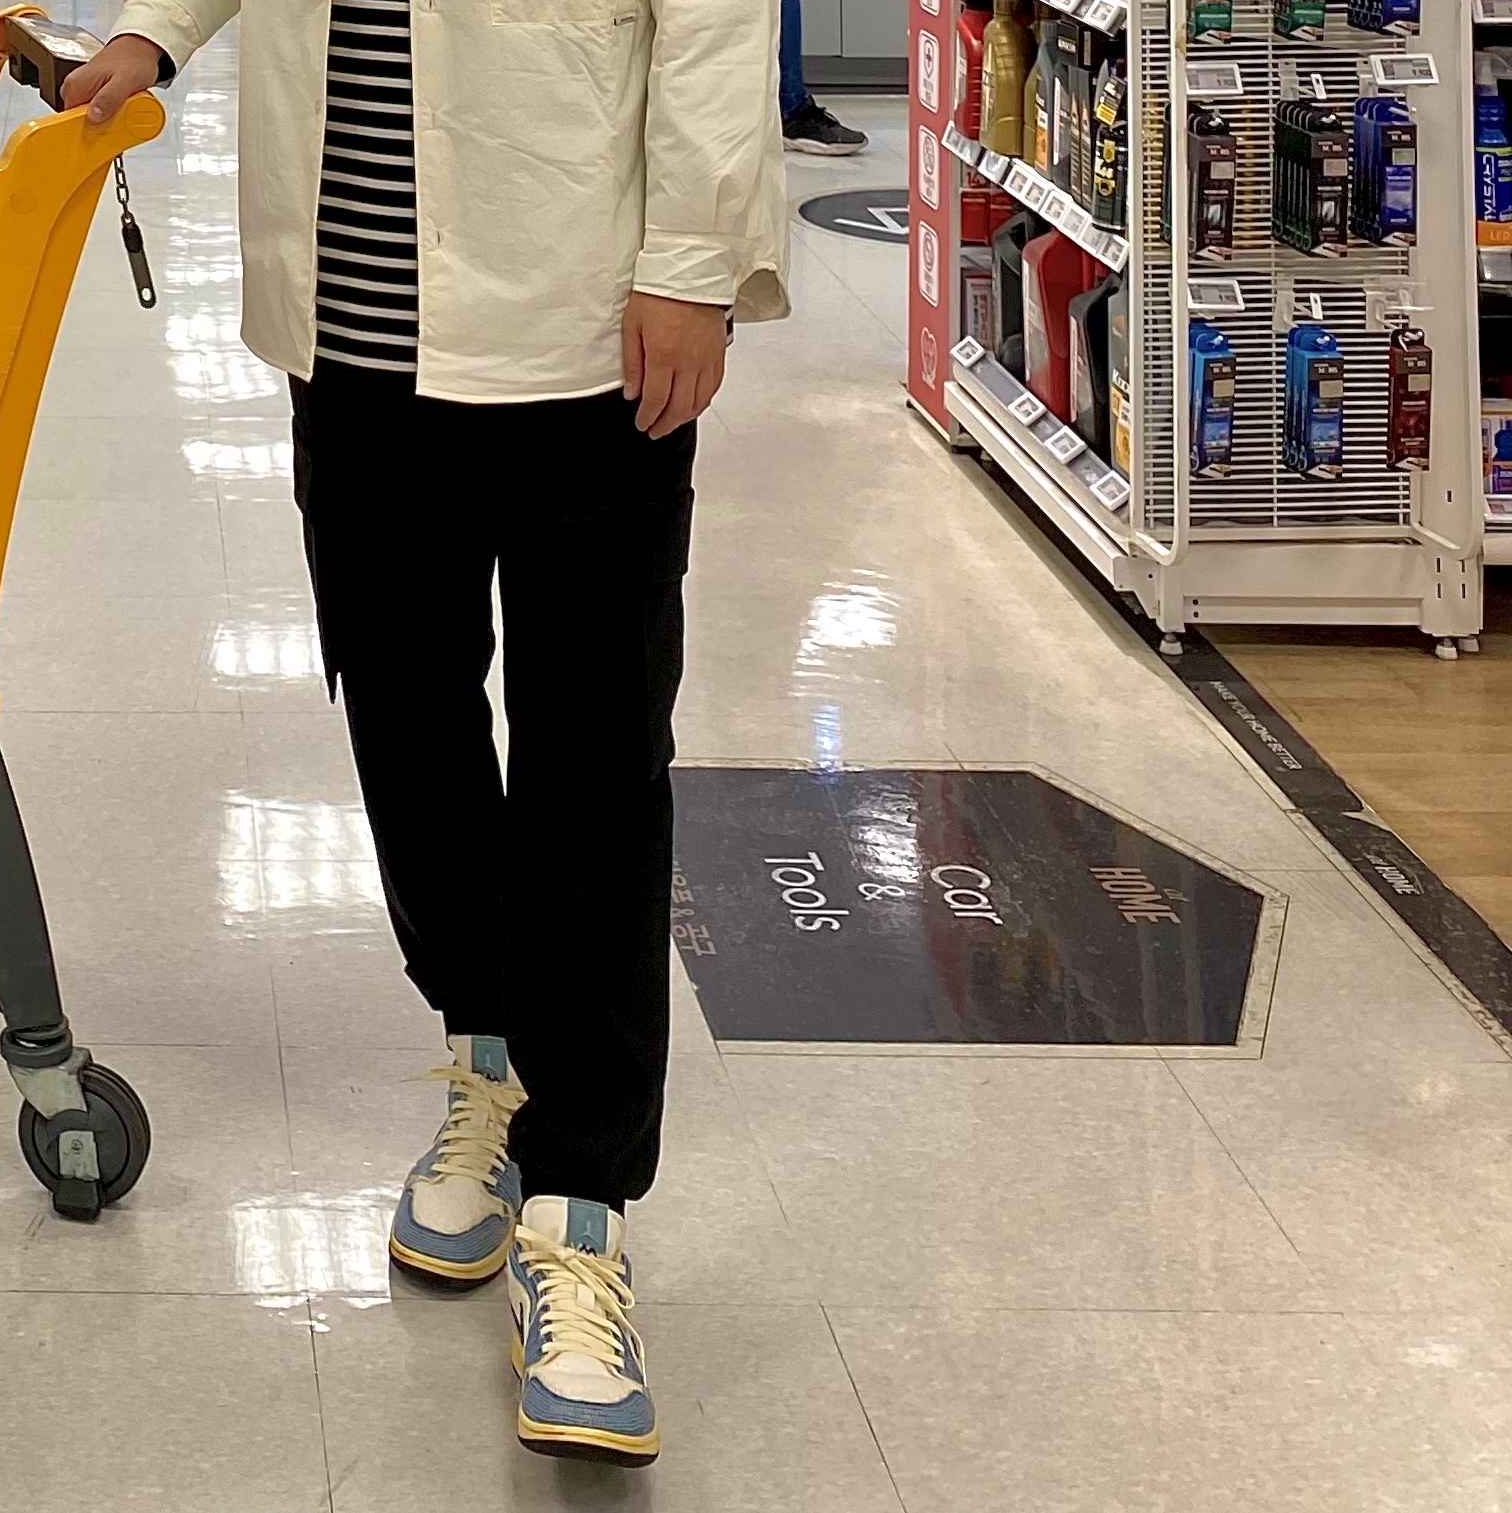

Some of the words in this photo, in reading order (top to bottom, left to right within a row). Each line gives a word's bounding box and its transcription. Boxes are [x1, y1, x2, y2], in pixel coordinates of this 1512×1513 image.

[1248, 719, 1277, 745] HOME
[764, 851, 850, 932] Tools
[858, 883, 906, 901] &
[930, 864, 1004, 926] Car
[1090, 866, 1181, 925] HOME
[1375, 865, 1421, 895] HOME
